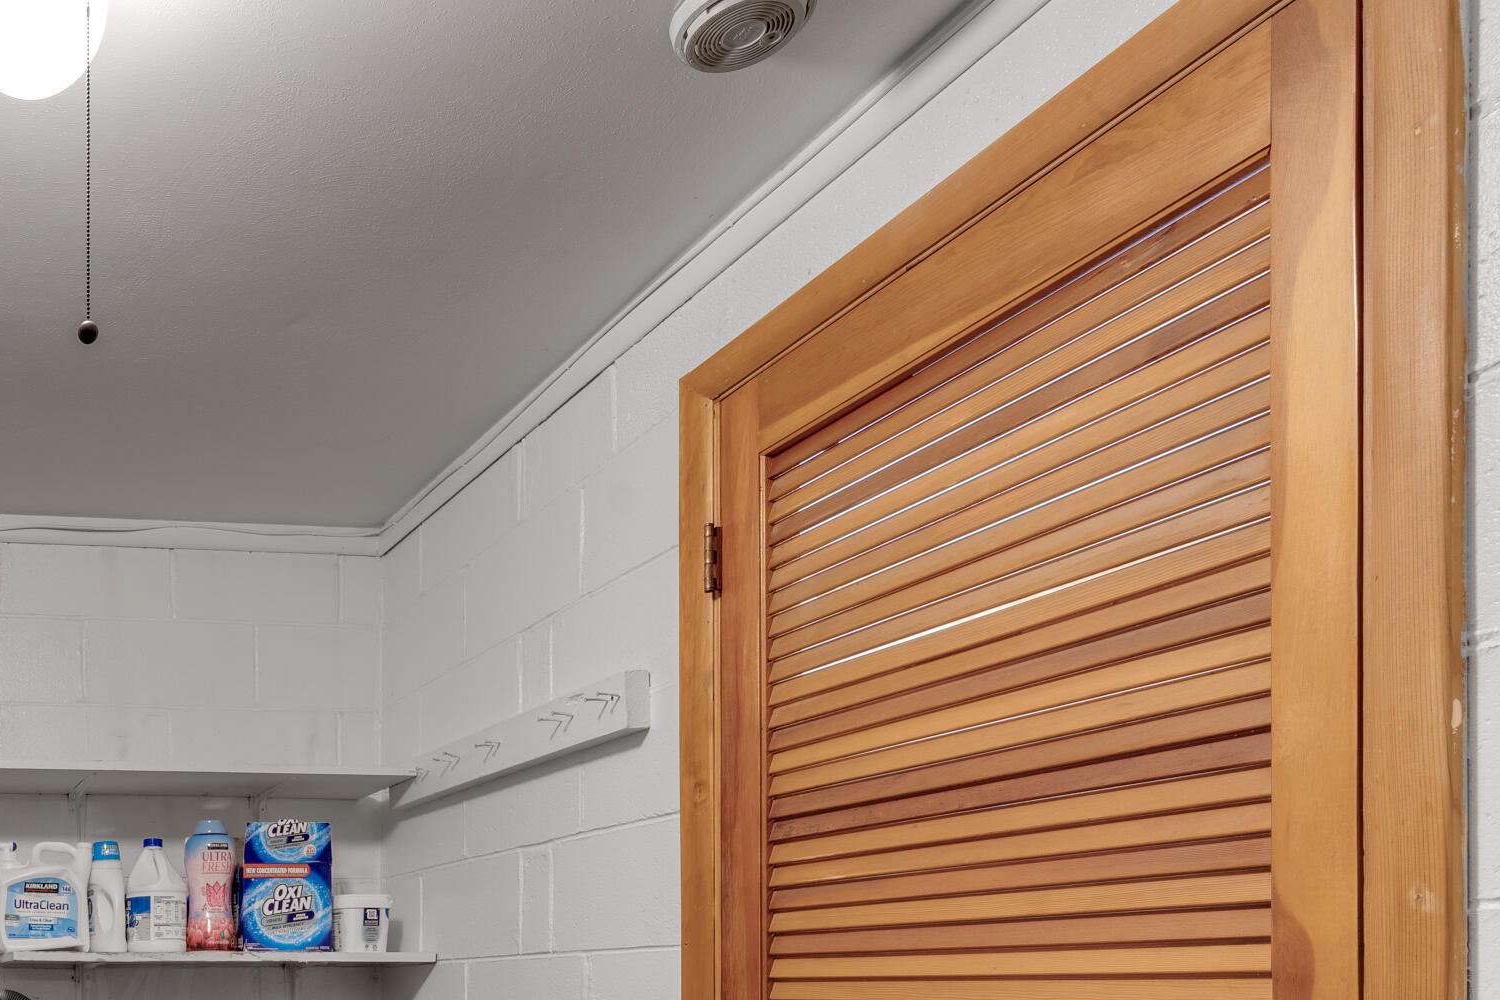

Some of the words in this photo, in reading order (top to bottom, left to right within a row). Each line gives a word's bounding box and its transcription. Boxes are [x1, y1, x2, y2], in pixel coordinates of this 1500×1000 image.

[267, 821, 308, 838] CLEAN
[202, 851, 232, 862] ULTRA
[274, 884, 303, 901] OXI
[14, 899, 69, 911] UltraClean
[262, 896, 312, 916] CLEAN
